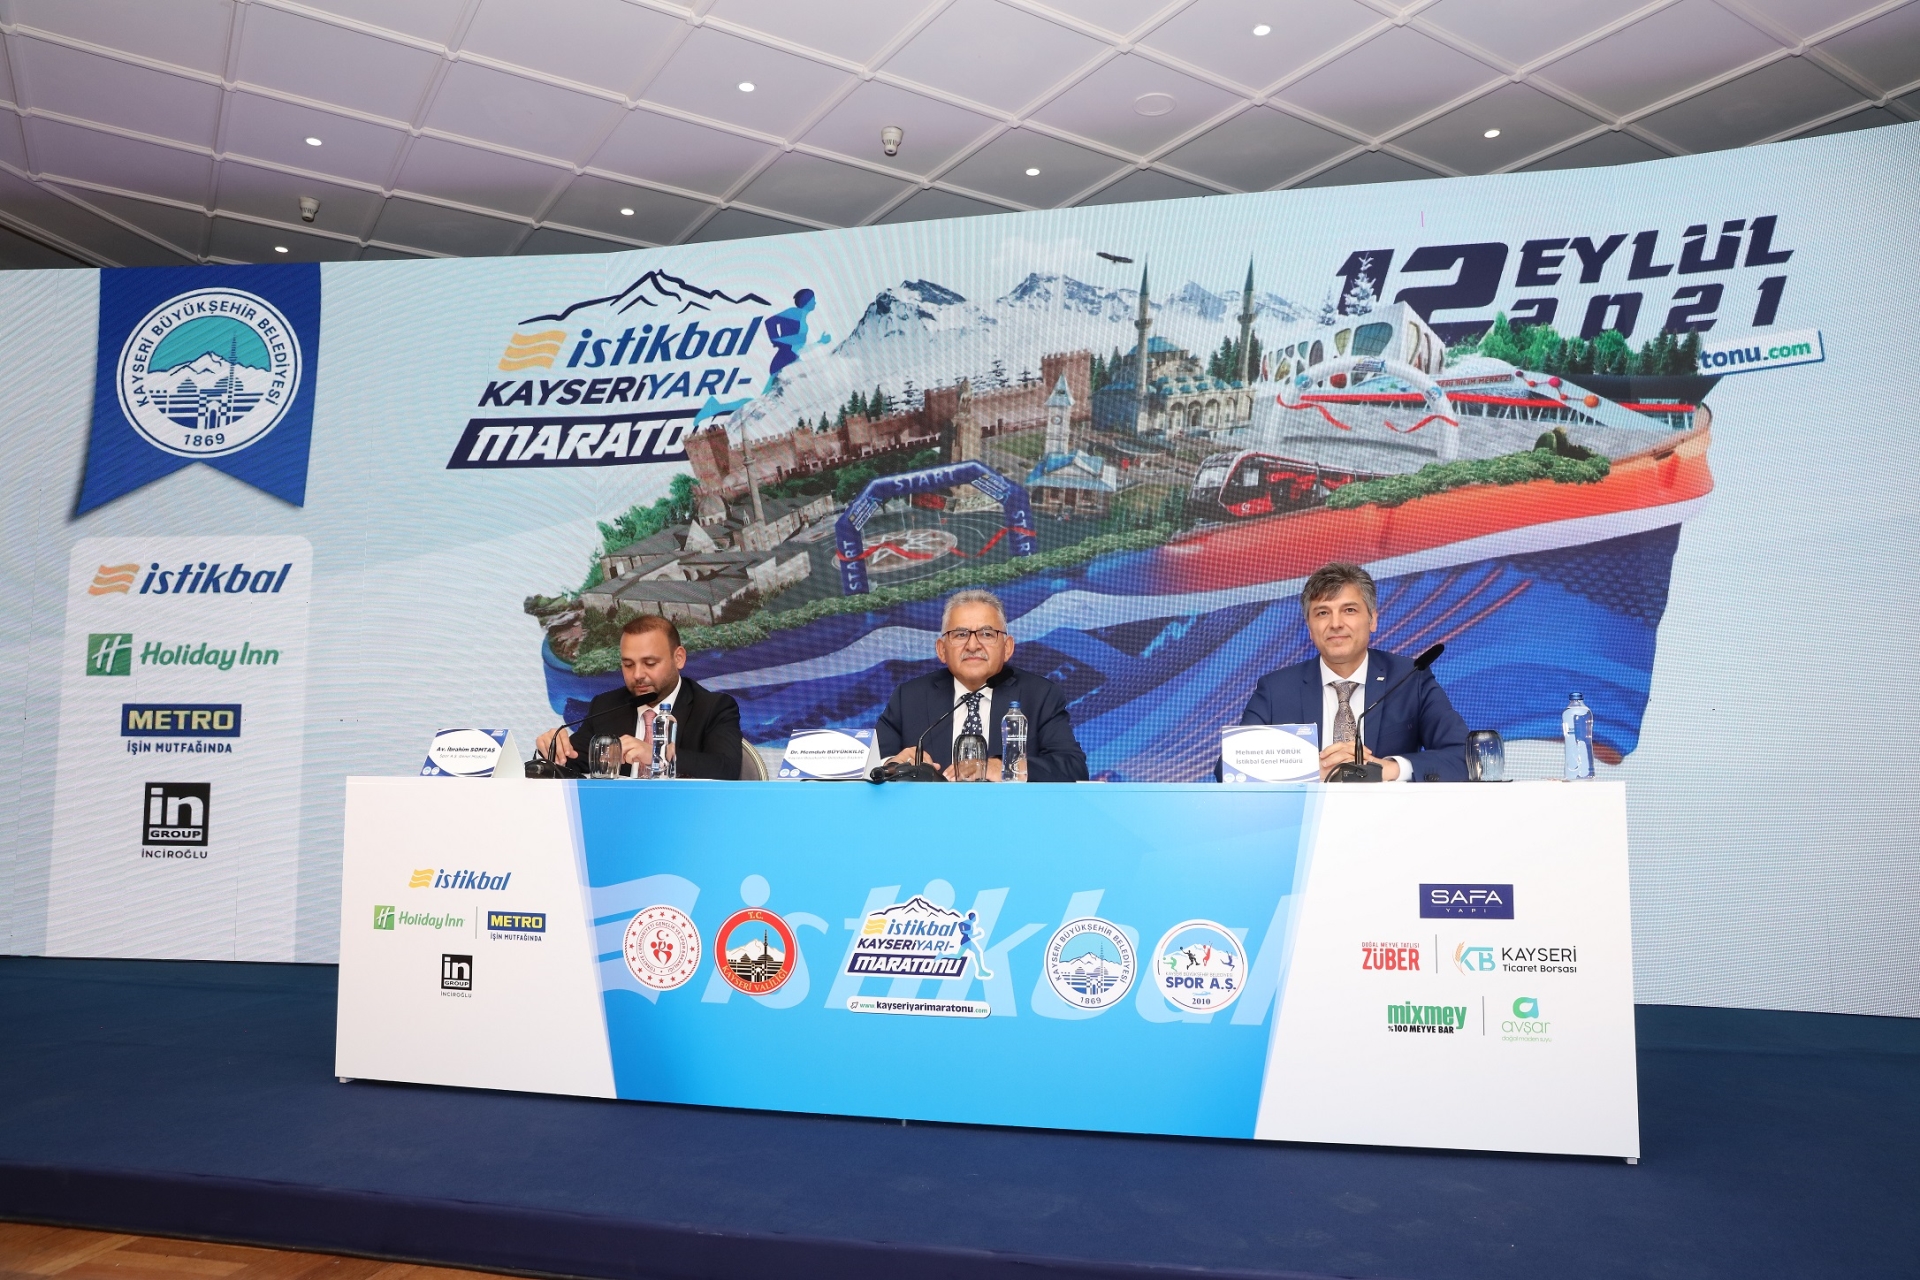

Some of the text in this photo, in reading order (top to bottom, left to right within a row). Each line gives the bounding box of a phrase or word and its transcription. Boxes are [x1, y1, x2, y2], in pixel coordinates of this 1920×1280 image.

[1336, 215, 1794, 348] 12 EYLÜL
[566, 316, 763, 368] istikbal
[132, 300, 290, 407] KAYSERİ BÜYÜKŞEHİR BELEDİYESİ
[184, 433, 226, 446] 1869
[894, 469, 955, 490] START
[1013, 510, 1031, 556] STAR
[844, 540, 860, 591] START
[139, 562, 293, 594] istikbal
[140, 642, 280, 671] Holiday Inn
[128, 710, 234, 730] METRO
[126, 740, 232, 755] İŞİN MUTFAĞINDA
[1276, 747, 1301, 755] YÖRÜK
[149, 788, 204, 826] in
[150, 829, 202, 839] GROUP
[141, 848, 208, 859] İNCİROĞLU
[434, 869, 512, 891] istikbal
[1431, 889, 1503, 905] SAFA
[398, 911, 464, 930] Holiday Inn
[490, 915, 543, 929] METRO
[747, 911, 764, 920] T.C.
[490, 932, 543, 942] İŞİN MUTFAĞINDA
[887, 918, 958, 937] istikbal
[1051, 923, 1132, 984] KAYSERİ BÜYÜKŞEHİR BELEDİYESİ
[1362, 948, 1420, 971] ZÜBER
[1501, 945, 1577, 962] KAYSERİ
[444, 956, 470, 979] in
[854, 955, 963, 974] MARATONU
[1502, 963, 1577, 973] Ticaret Borsası
[722, 965, 788, 991] KAYSERİ VALİLİĞİ
[1165, 976, 1237, 993] SPOR A.Ş.
[1080, 997, 1102, 1005] 1869
[1192, 997, 1211, 1005] 2010
[1387, 1001, 1467, 1030] mixmey
[1387, 1025, 1454, 1034] %100 MEYVE BAR
[1501, 1020, 1551, 1035] avşar
